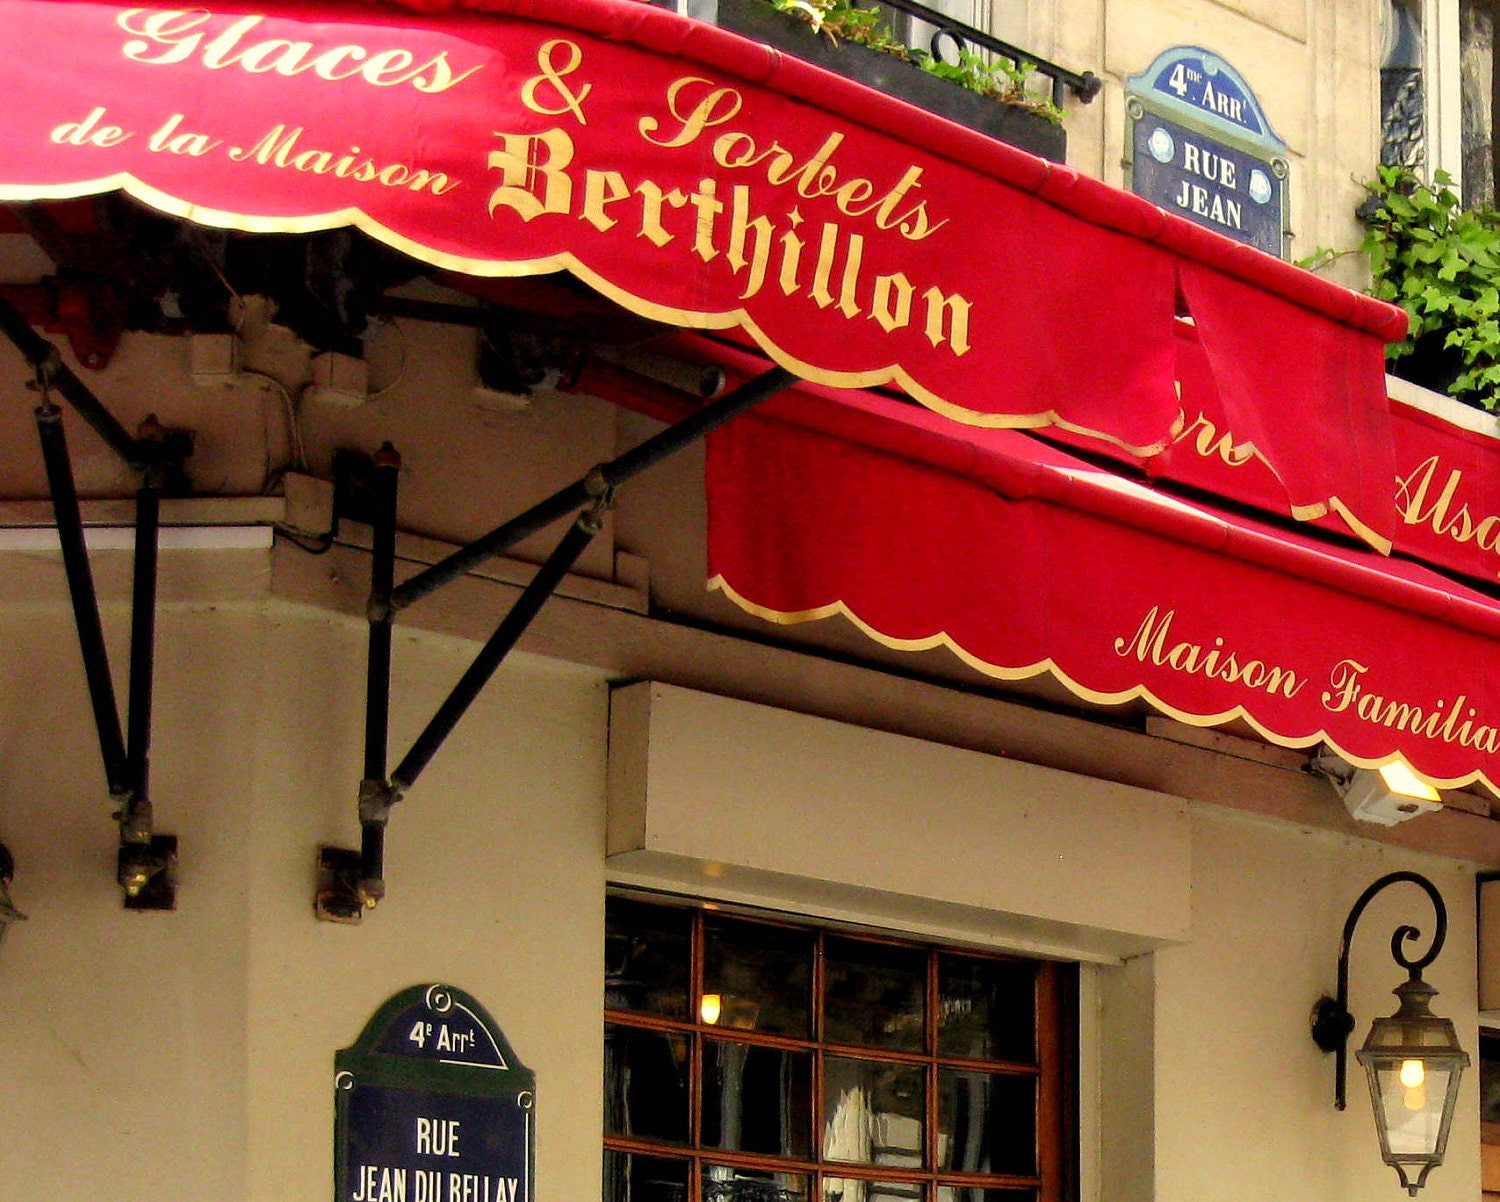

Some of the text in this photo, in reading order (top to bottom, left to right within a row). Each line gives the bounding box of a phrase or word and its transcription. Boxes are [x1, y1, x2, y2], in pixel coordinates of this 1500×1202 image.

[117, 7, 949, 240] Glaces & Sorbets
[1184, 142, 1236, 189] RUE
[1176, 180, 1241, 229] JEAN
[51, 107, 973, 356] de la Maison Berthillon
[1114, 605, 1308, 698] Maison
[410, 1021, 476, 1053] 4e Arrt
[416, 1118, 460, 1157] RUE
